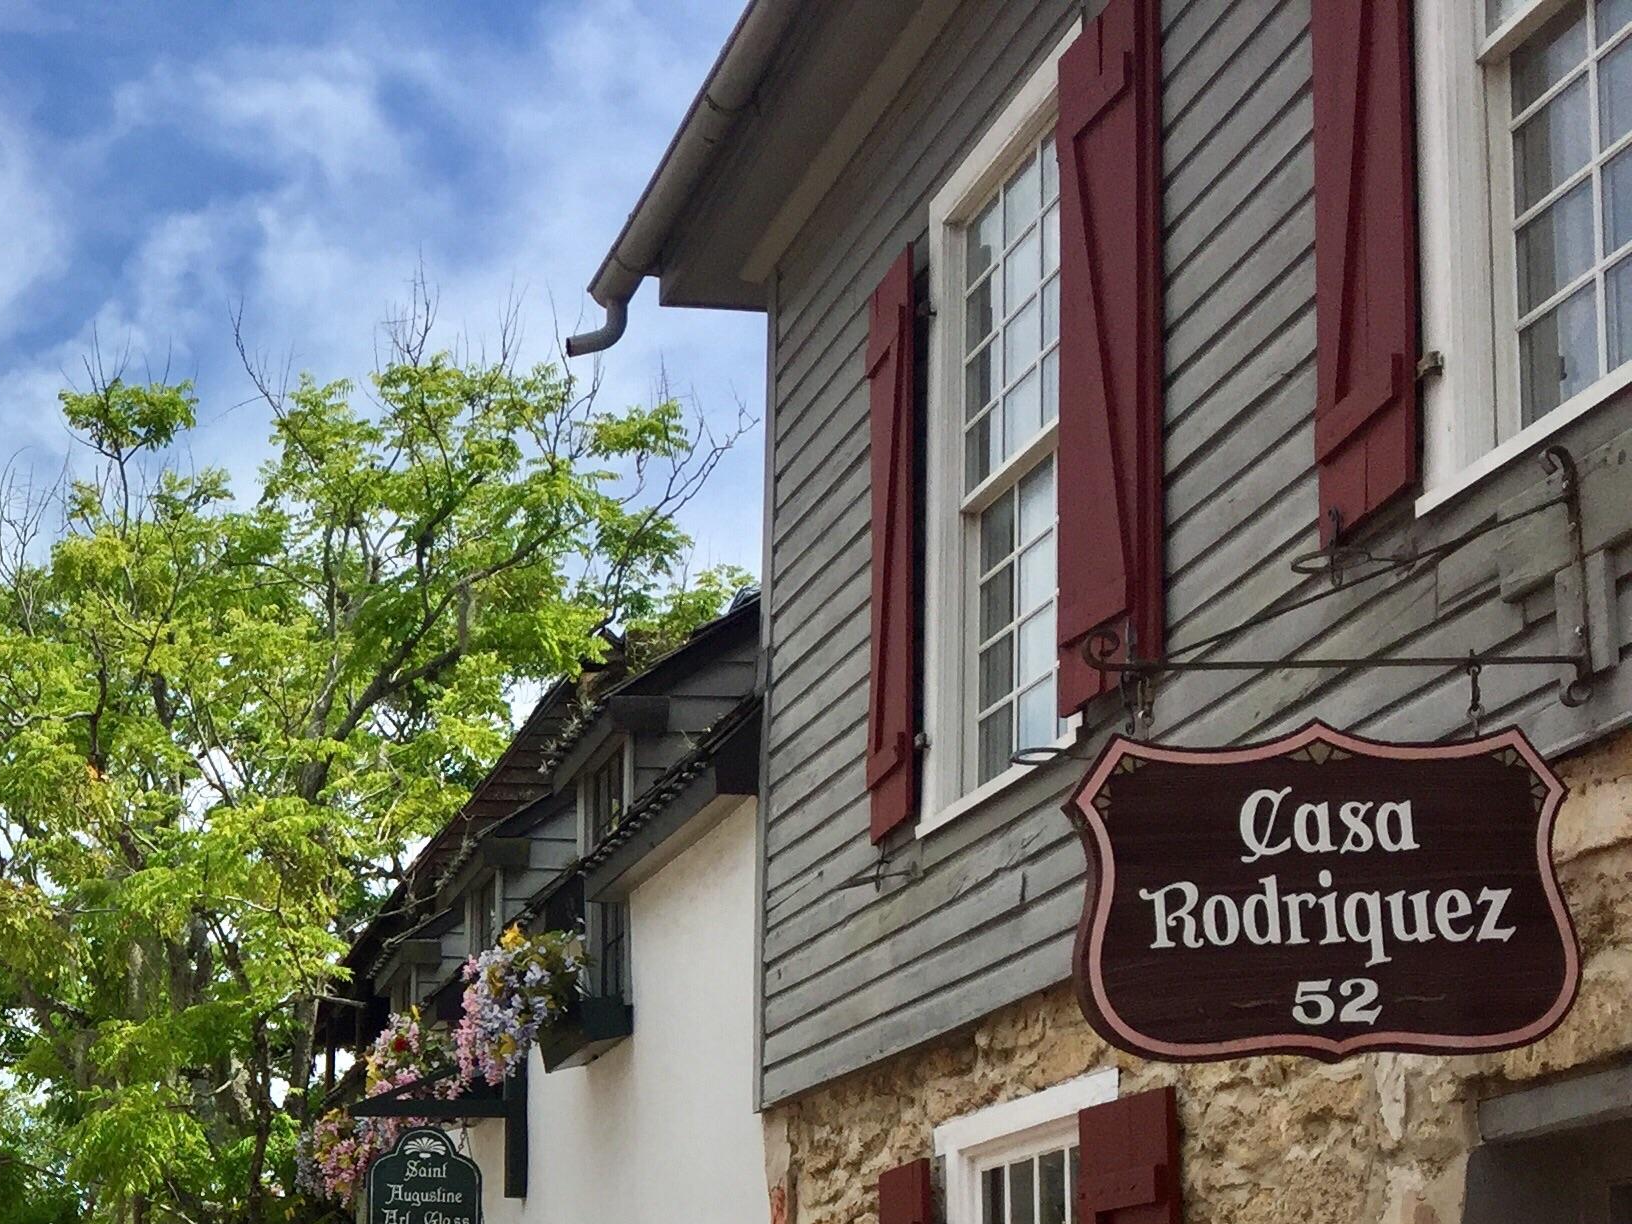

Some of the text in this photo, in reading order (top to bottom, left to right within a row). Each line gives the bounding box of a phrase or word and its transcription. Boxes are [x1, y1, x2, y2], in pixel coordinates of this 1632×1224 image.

[1239, 785, 1420, 863] Casa
[1139, 870, 1517, 969] Rodriquez
[1291, 978, 1383, 1026] 52
[404, 1159, 448, 1181] Saint
[385, 1183, 463, 1206] Augustine
